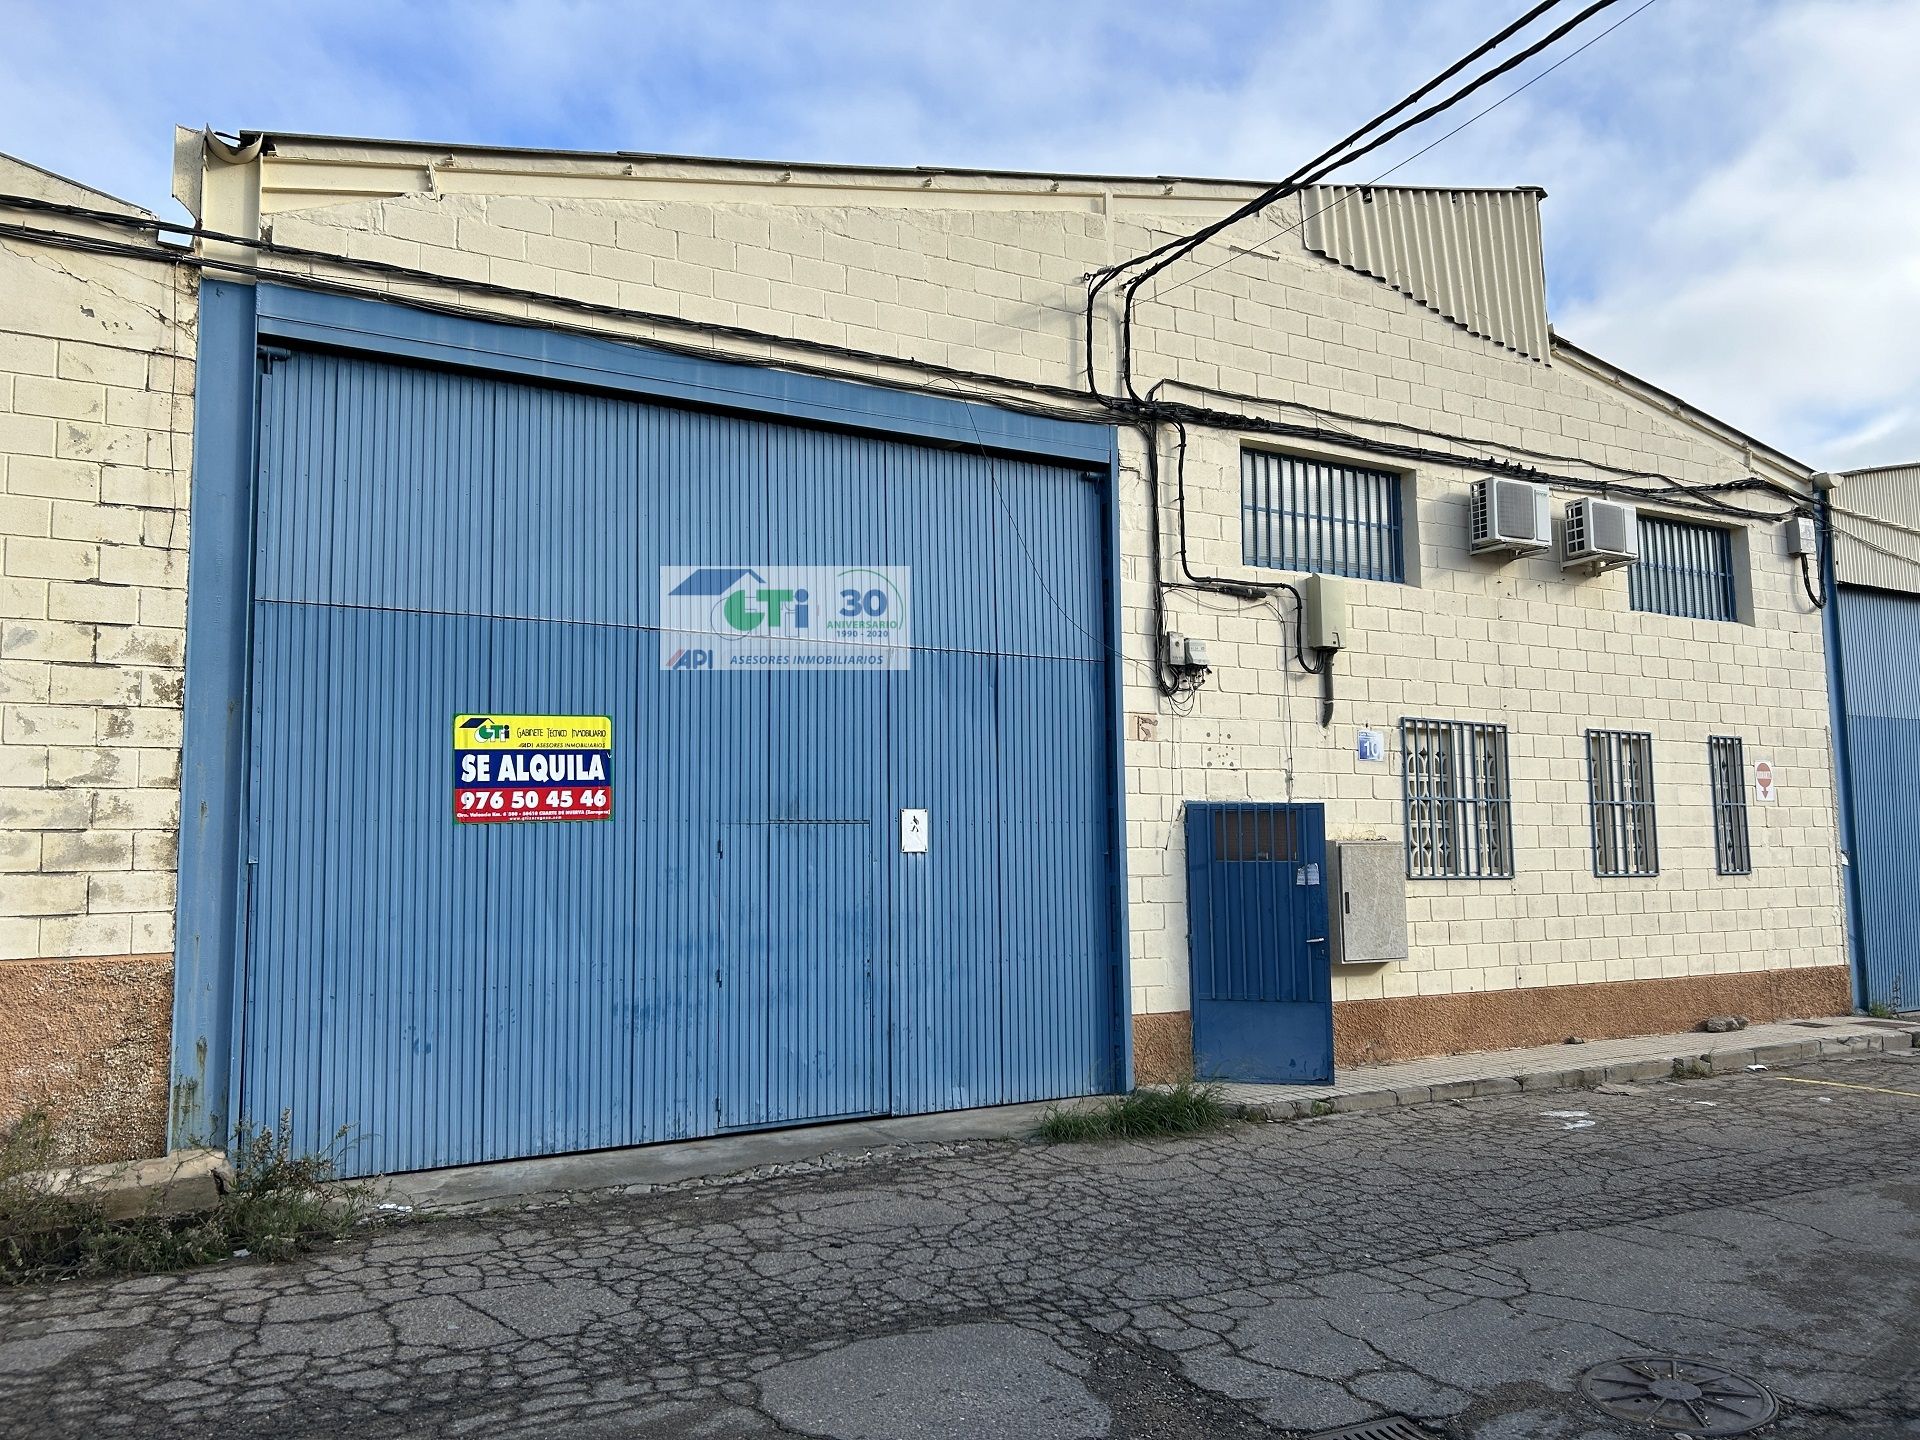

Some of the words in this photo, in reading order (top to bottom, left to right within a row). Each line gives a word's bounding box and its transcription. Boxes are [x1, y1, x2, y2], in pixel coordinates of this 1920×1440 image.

[1364, 740, 1380, 757] 10
[461, 754, 490, 783] SE
[497, 754, 606, 783] ALQUILA
[461, 791, 504, 810] 976
[511, 790, 539, 809] 50
[545, 790, 573, 808] 45
[580, 789, 607, 807] 46
